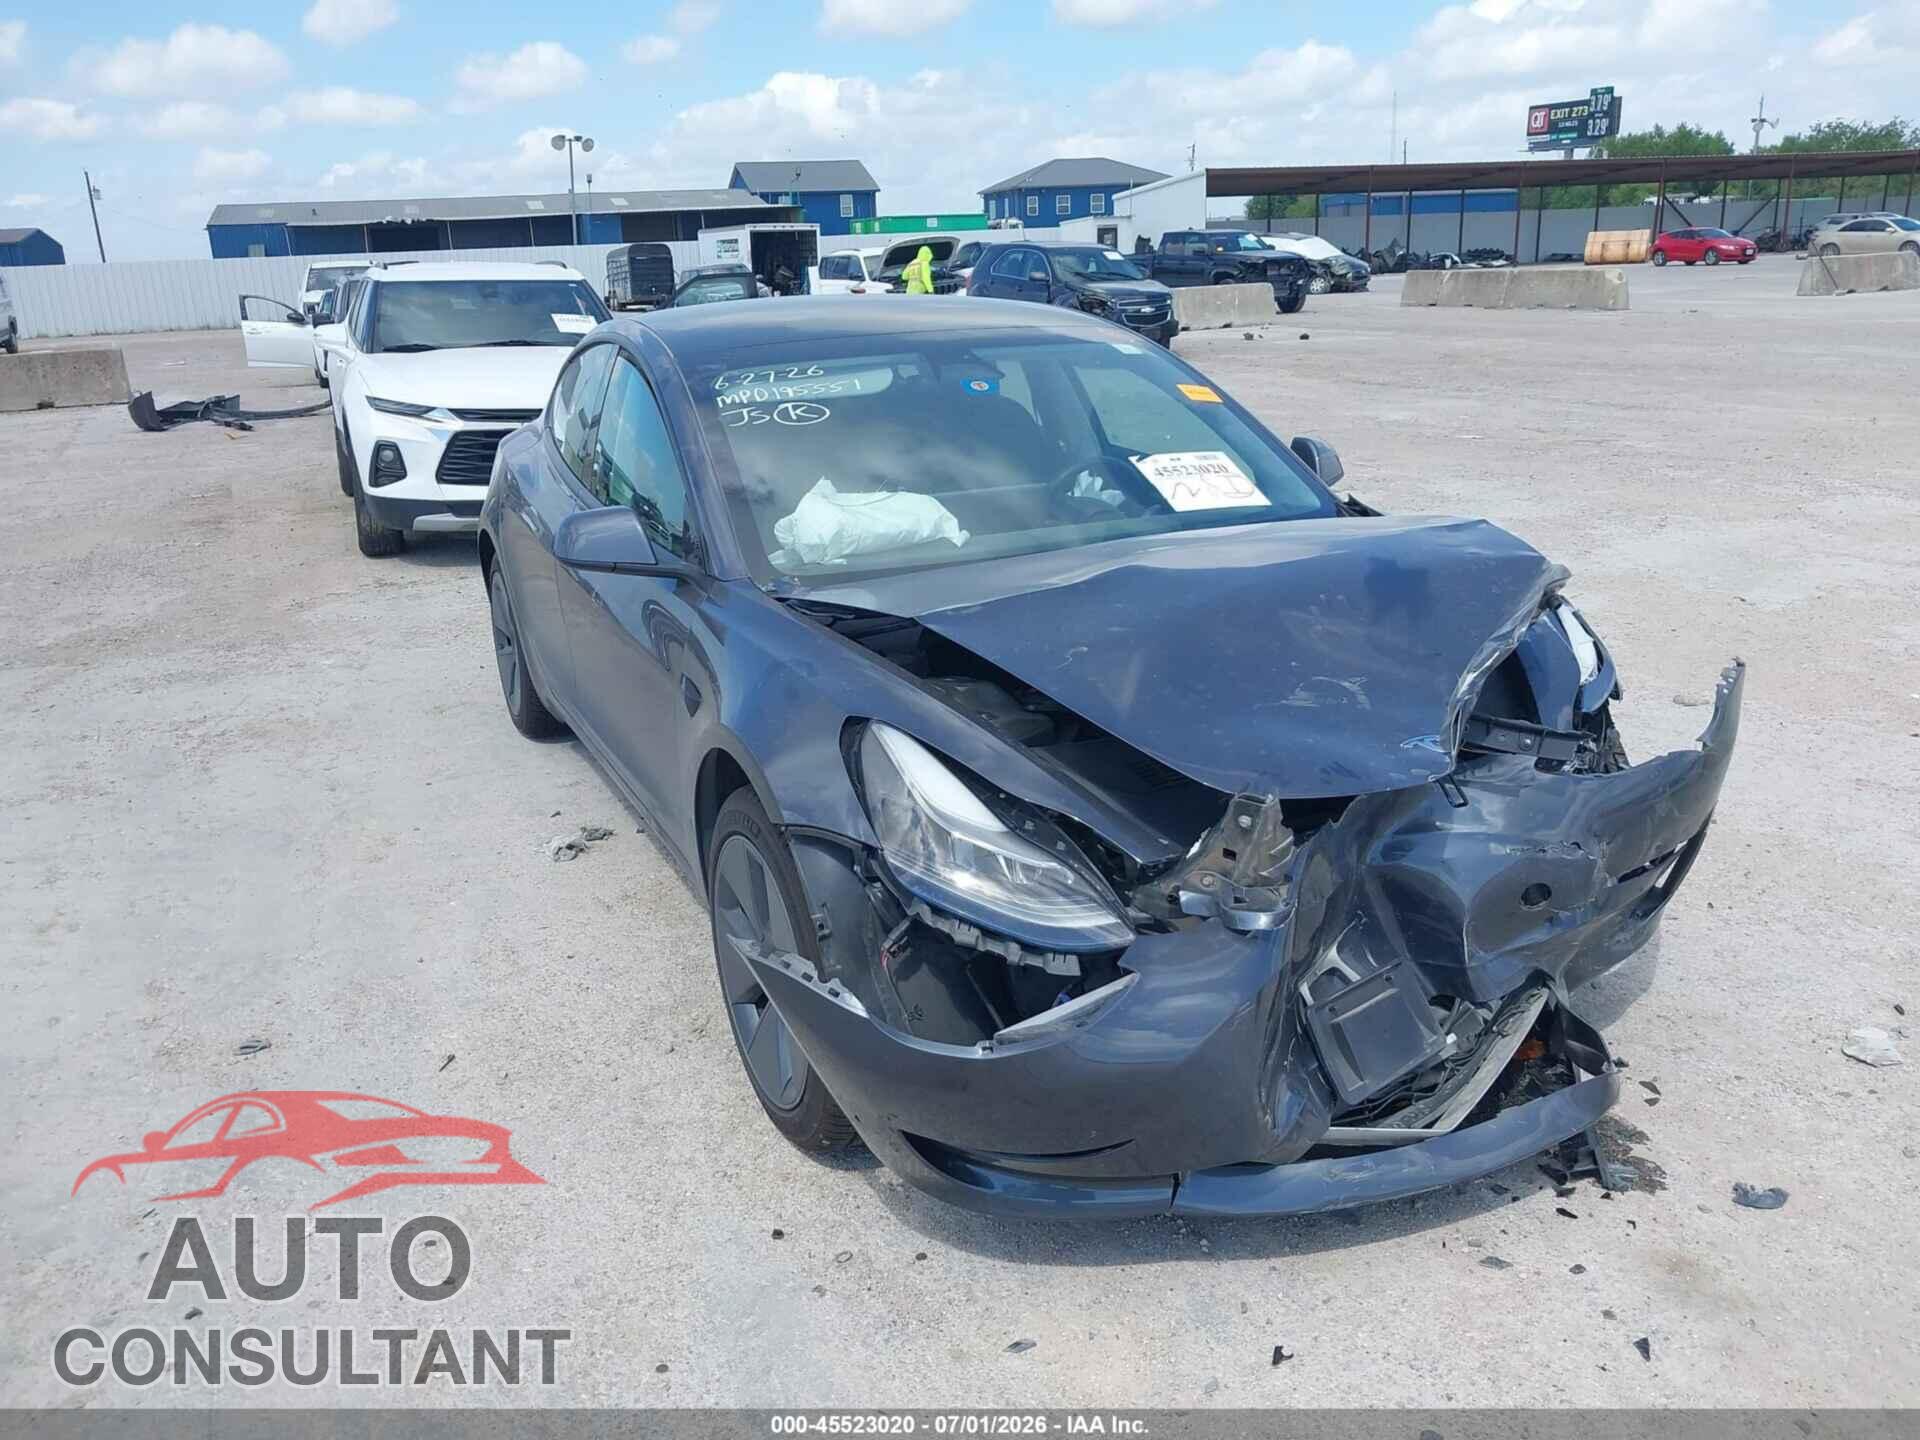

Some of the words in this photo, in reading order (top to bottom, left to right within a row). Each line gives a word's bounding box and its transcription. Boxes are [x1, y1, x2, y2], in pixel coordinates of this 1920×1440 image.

[1531, 111, 1545, 128] QT
[1550, 107, 1571, 120] EXIT
[1571, 105, 1589, 117] 273
[715, 365, 824, 390] 6-27-26
